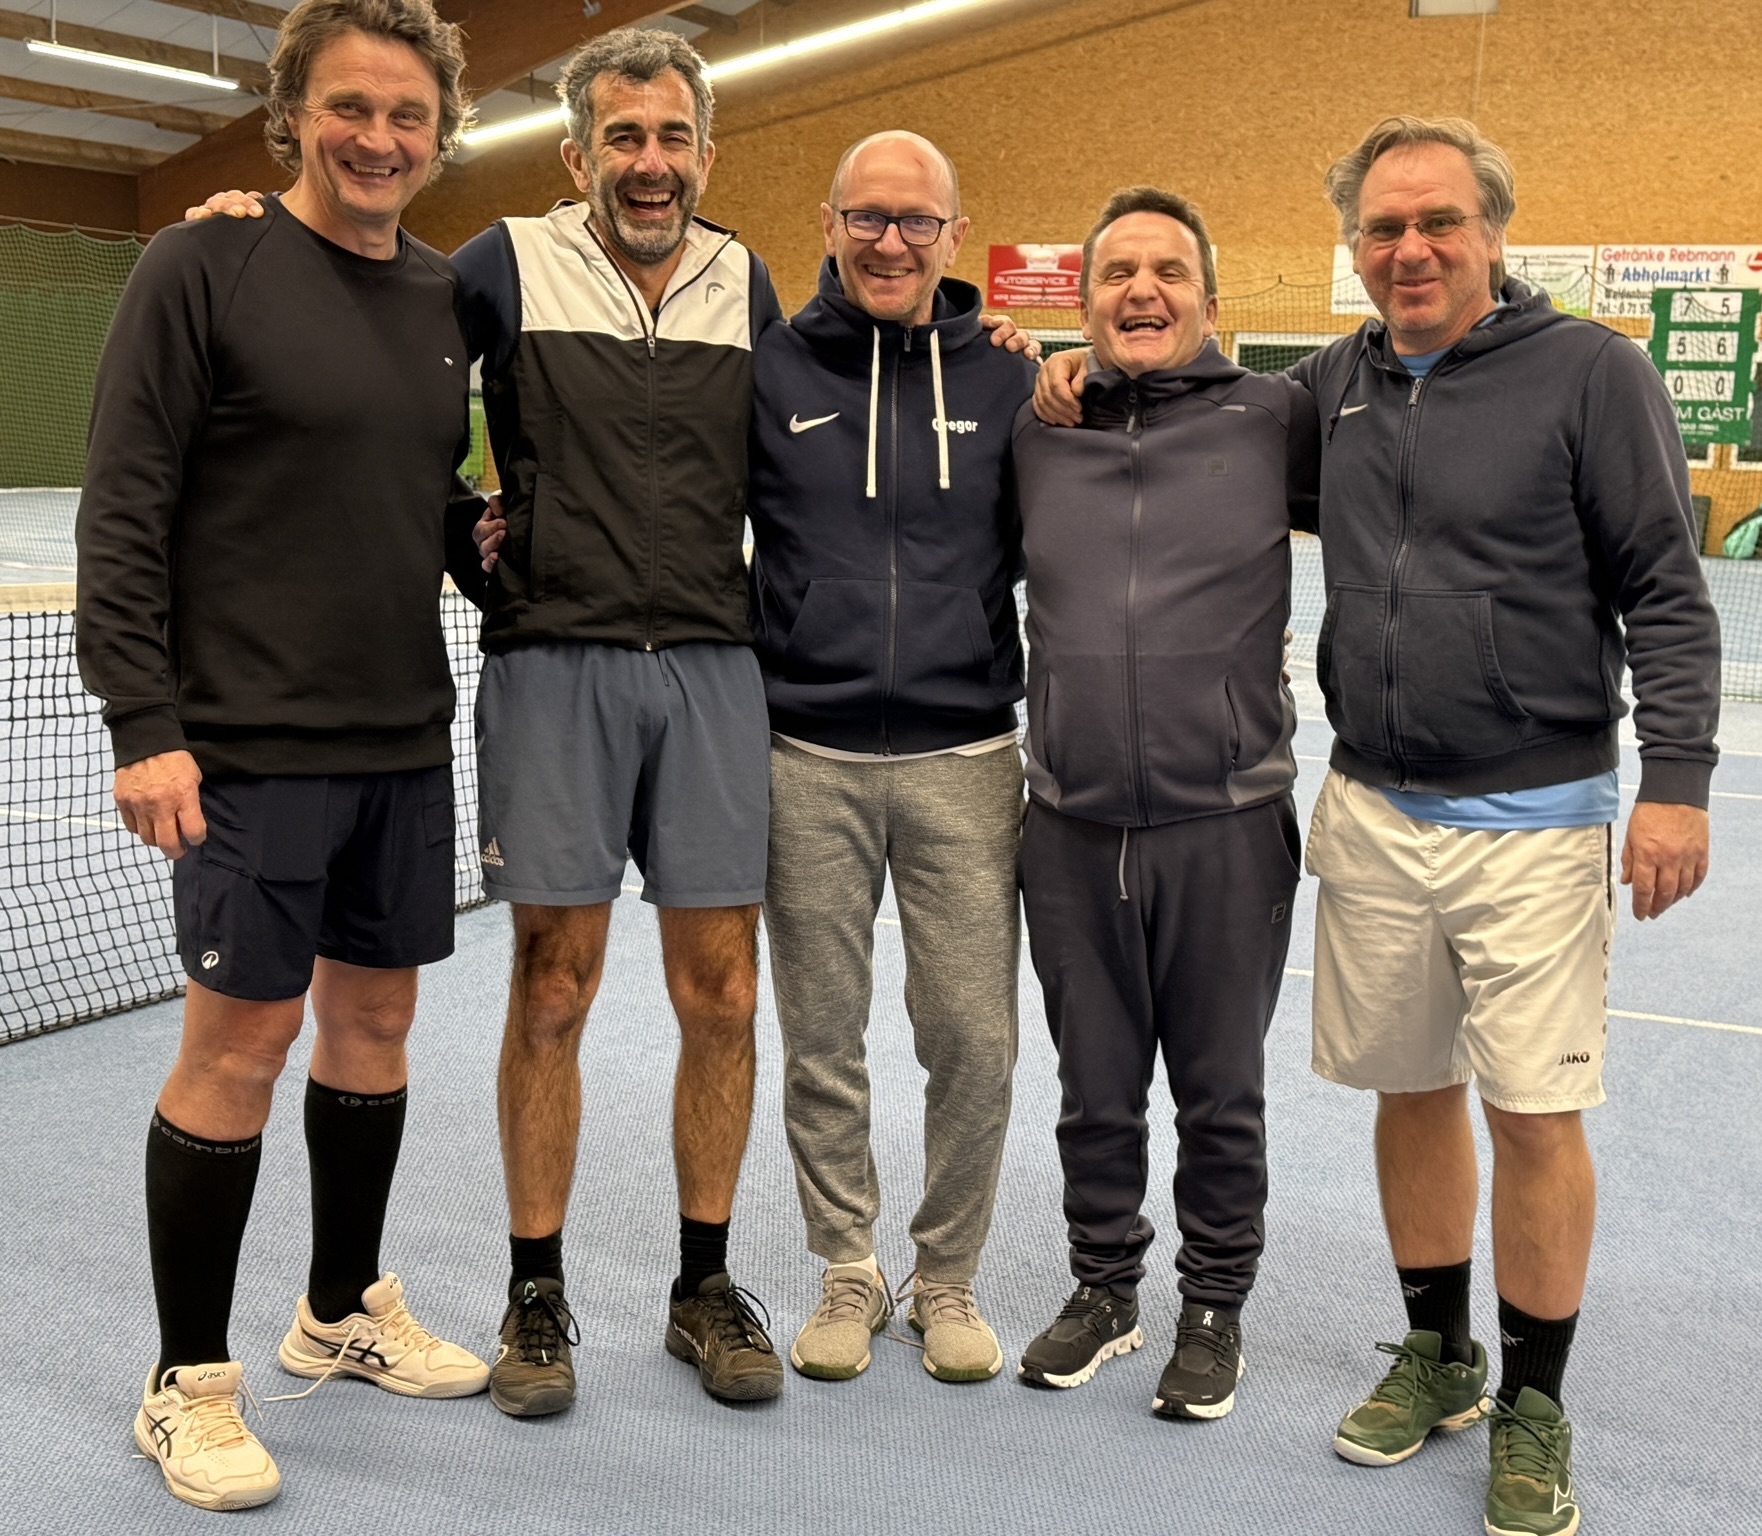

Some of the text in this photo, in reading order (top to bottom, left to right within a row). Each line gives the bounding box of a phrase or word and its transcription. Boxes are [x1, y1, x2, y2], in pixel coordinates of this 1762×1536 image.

[1601, 248, 1665, 263] Getränke
[1669, 249, 1736, 262] Rebmann
[994, 275, 1068, 286] AUTOSERVICE
[1621, 267, 1711, 282] Abholmarkt
[1684, 297, 1730, 316] 7 5
[1677, 336, 1726, 355] 5 6
[1673, 375, 1725, 395] 0 0
[1697, 406, 1745, 421] GAST
[481, 854, 505, 867] adidas
[1558, 1051, 1590, 1066] JAKO
[207, 1370, 227, 1380] asics
